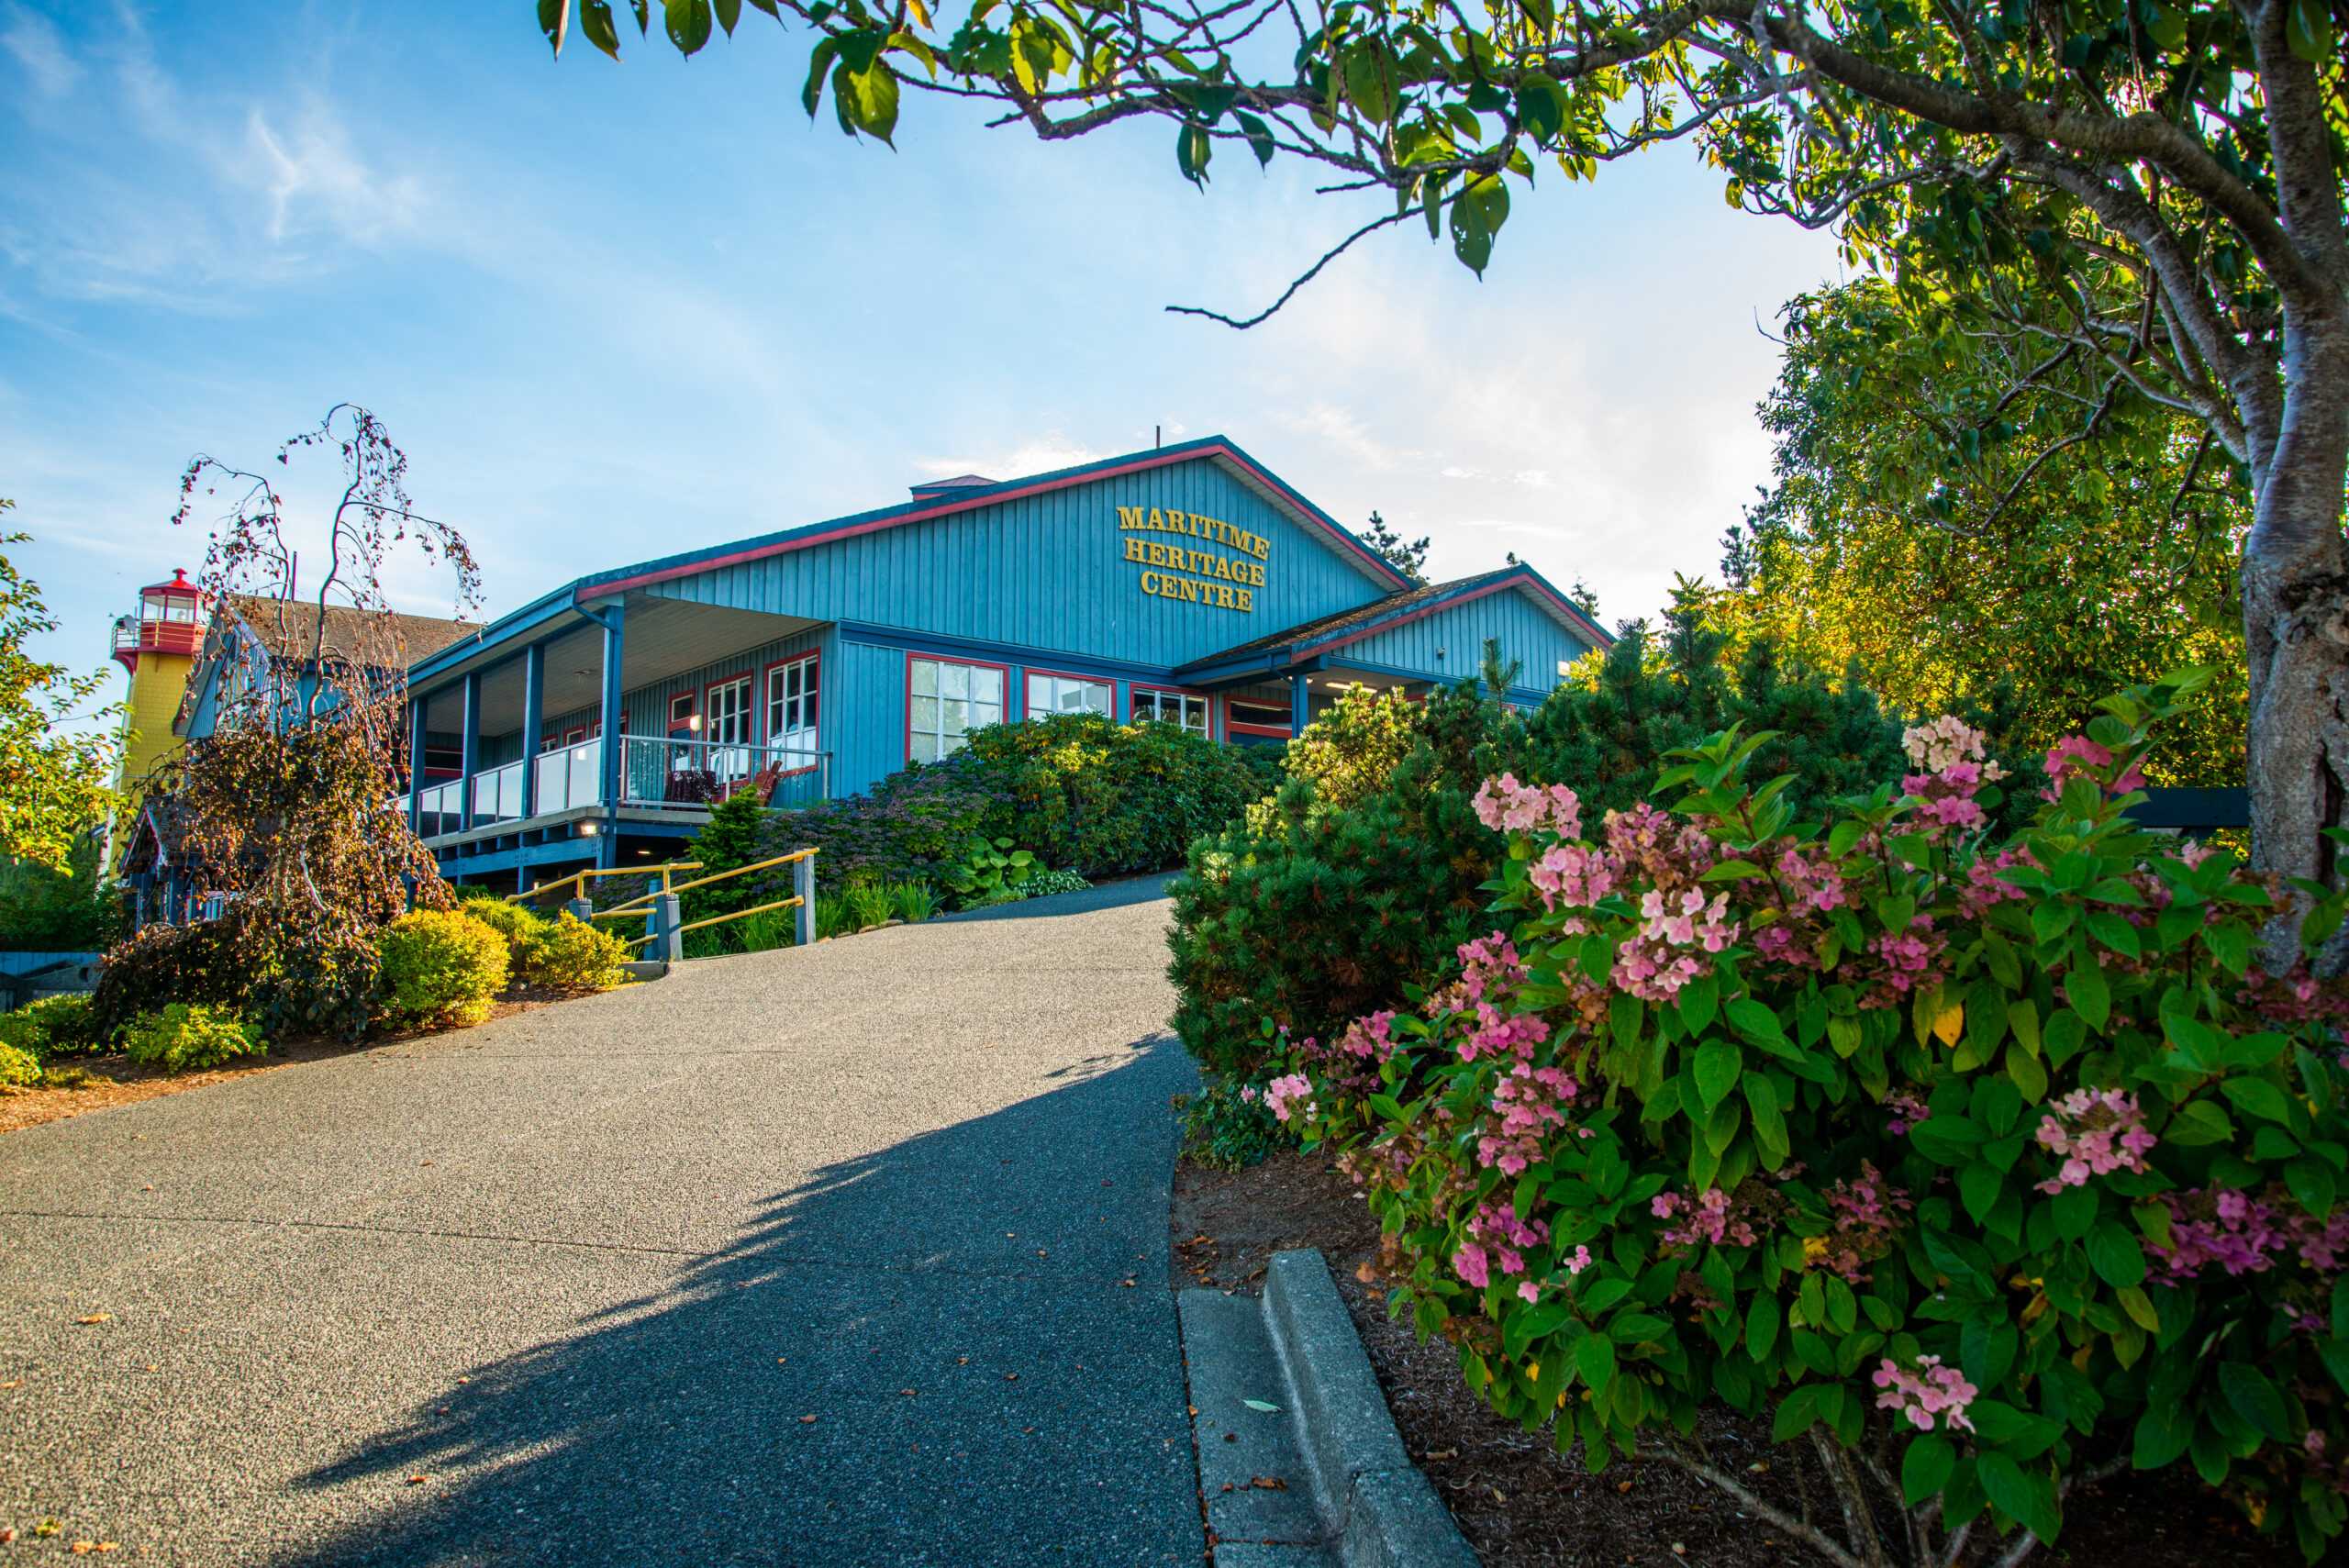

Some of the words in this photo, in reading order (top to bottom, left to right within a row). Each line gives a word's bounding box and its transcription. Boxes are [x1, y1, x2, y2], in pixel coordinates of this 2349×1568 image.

[1117, 506, 1271, 562] MARITIME
[1124, 538, 1265, 587] HERITAGE
[1141, 571, 1253, 613] CENTRE
